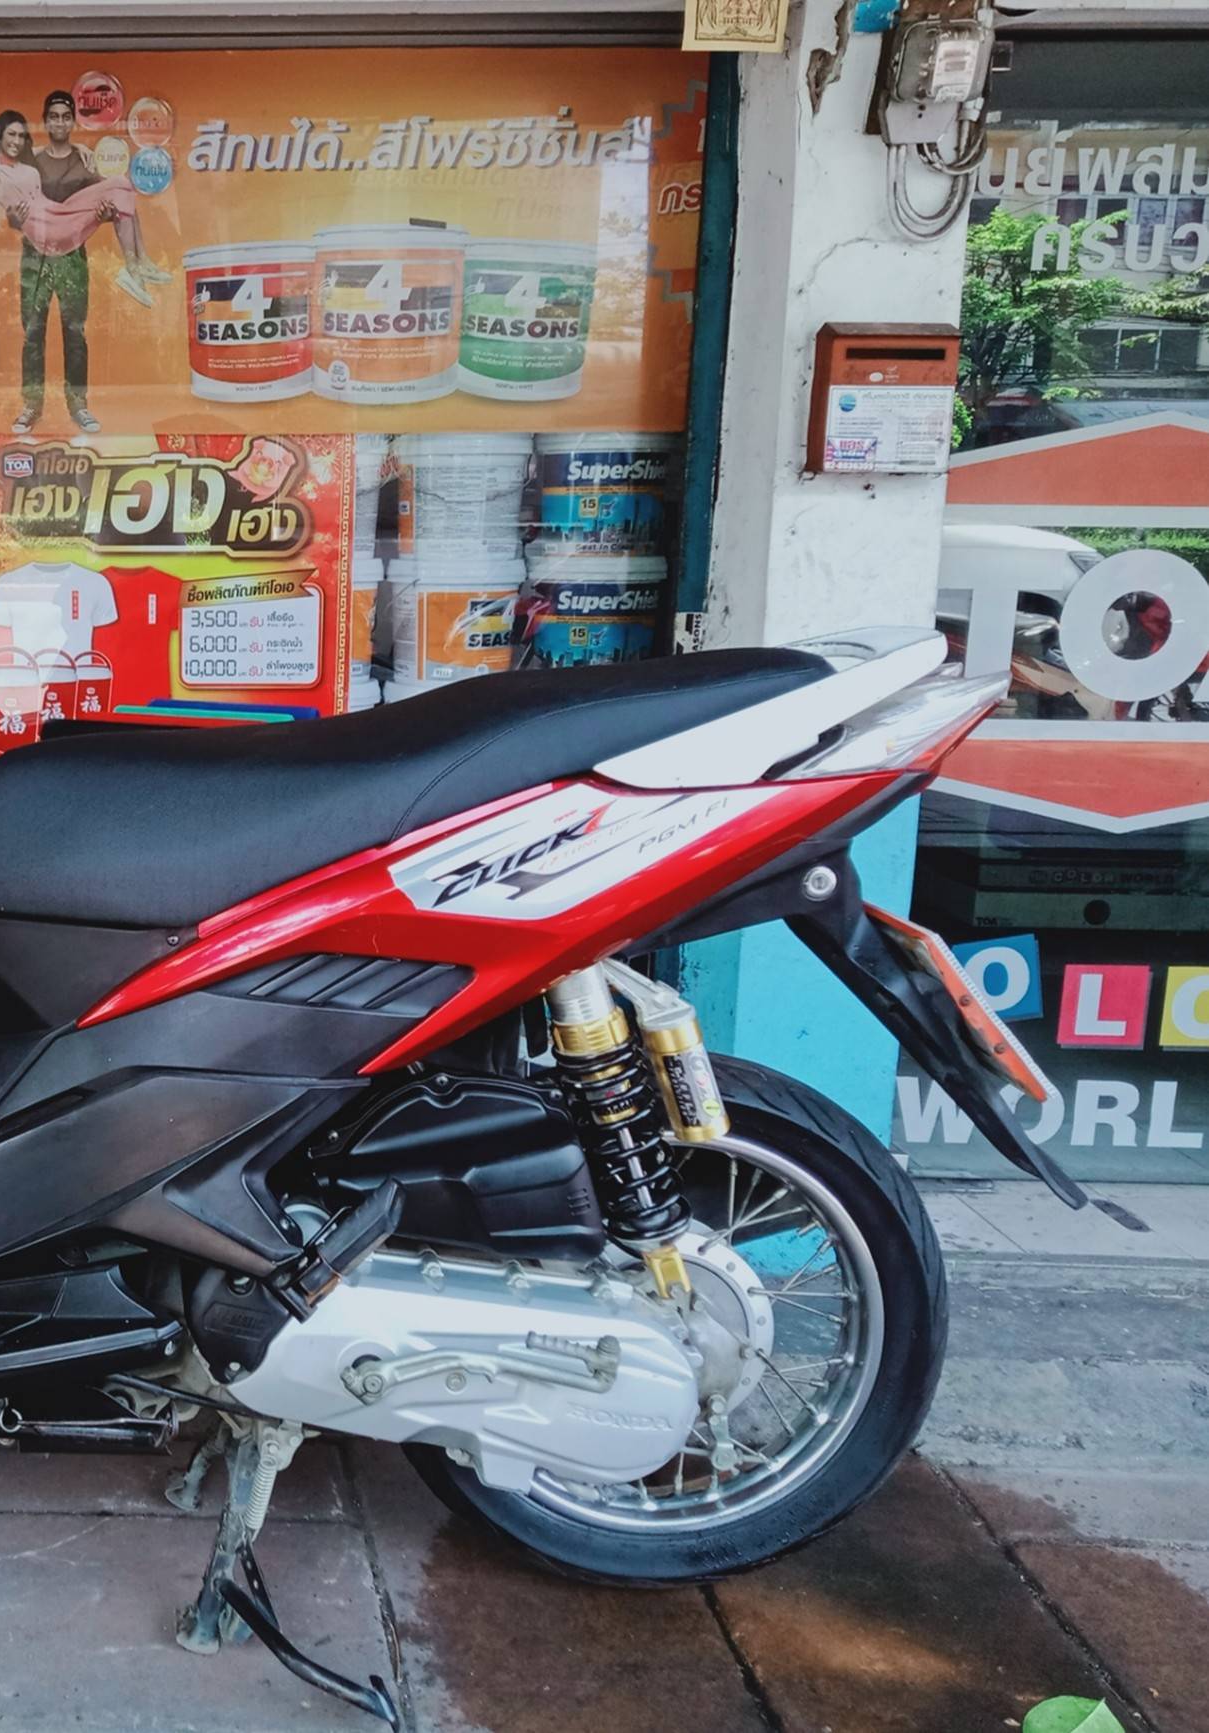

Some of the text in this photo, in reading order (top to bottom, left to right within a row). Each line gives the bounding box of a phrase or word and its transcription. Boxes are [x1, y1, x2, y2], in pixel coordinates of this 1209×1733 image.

[365, 261, 412, 311] 4
[505, 272, 547, 318] 4
[231, 277, 273, 320] 4
[198, 317, 308, 341] SEASONS
[324, 312, 450, 334] SEASONS
[465, 315, 579, 338] SEASONS
[6, 459, 31, 471] TOA
[13, 463, 297, 542] เฮง เฮง เฮง
[581, 498, 596, 510] 15
[191, 610, 237, 629] 3,500
[571, 627, 586, 638] 15
[185, 660, 237, 678] 10,000
[80, 696, 102, 713] 福
